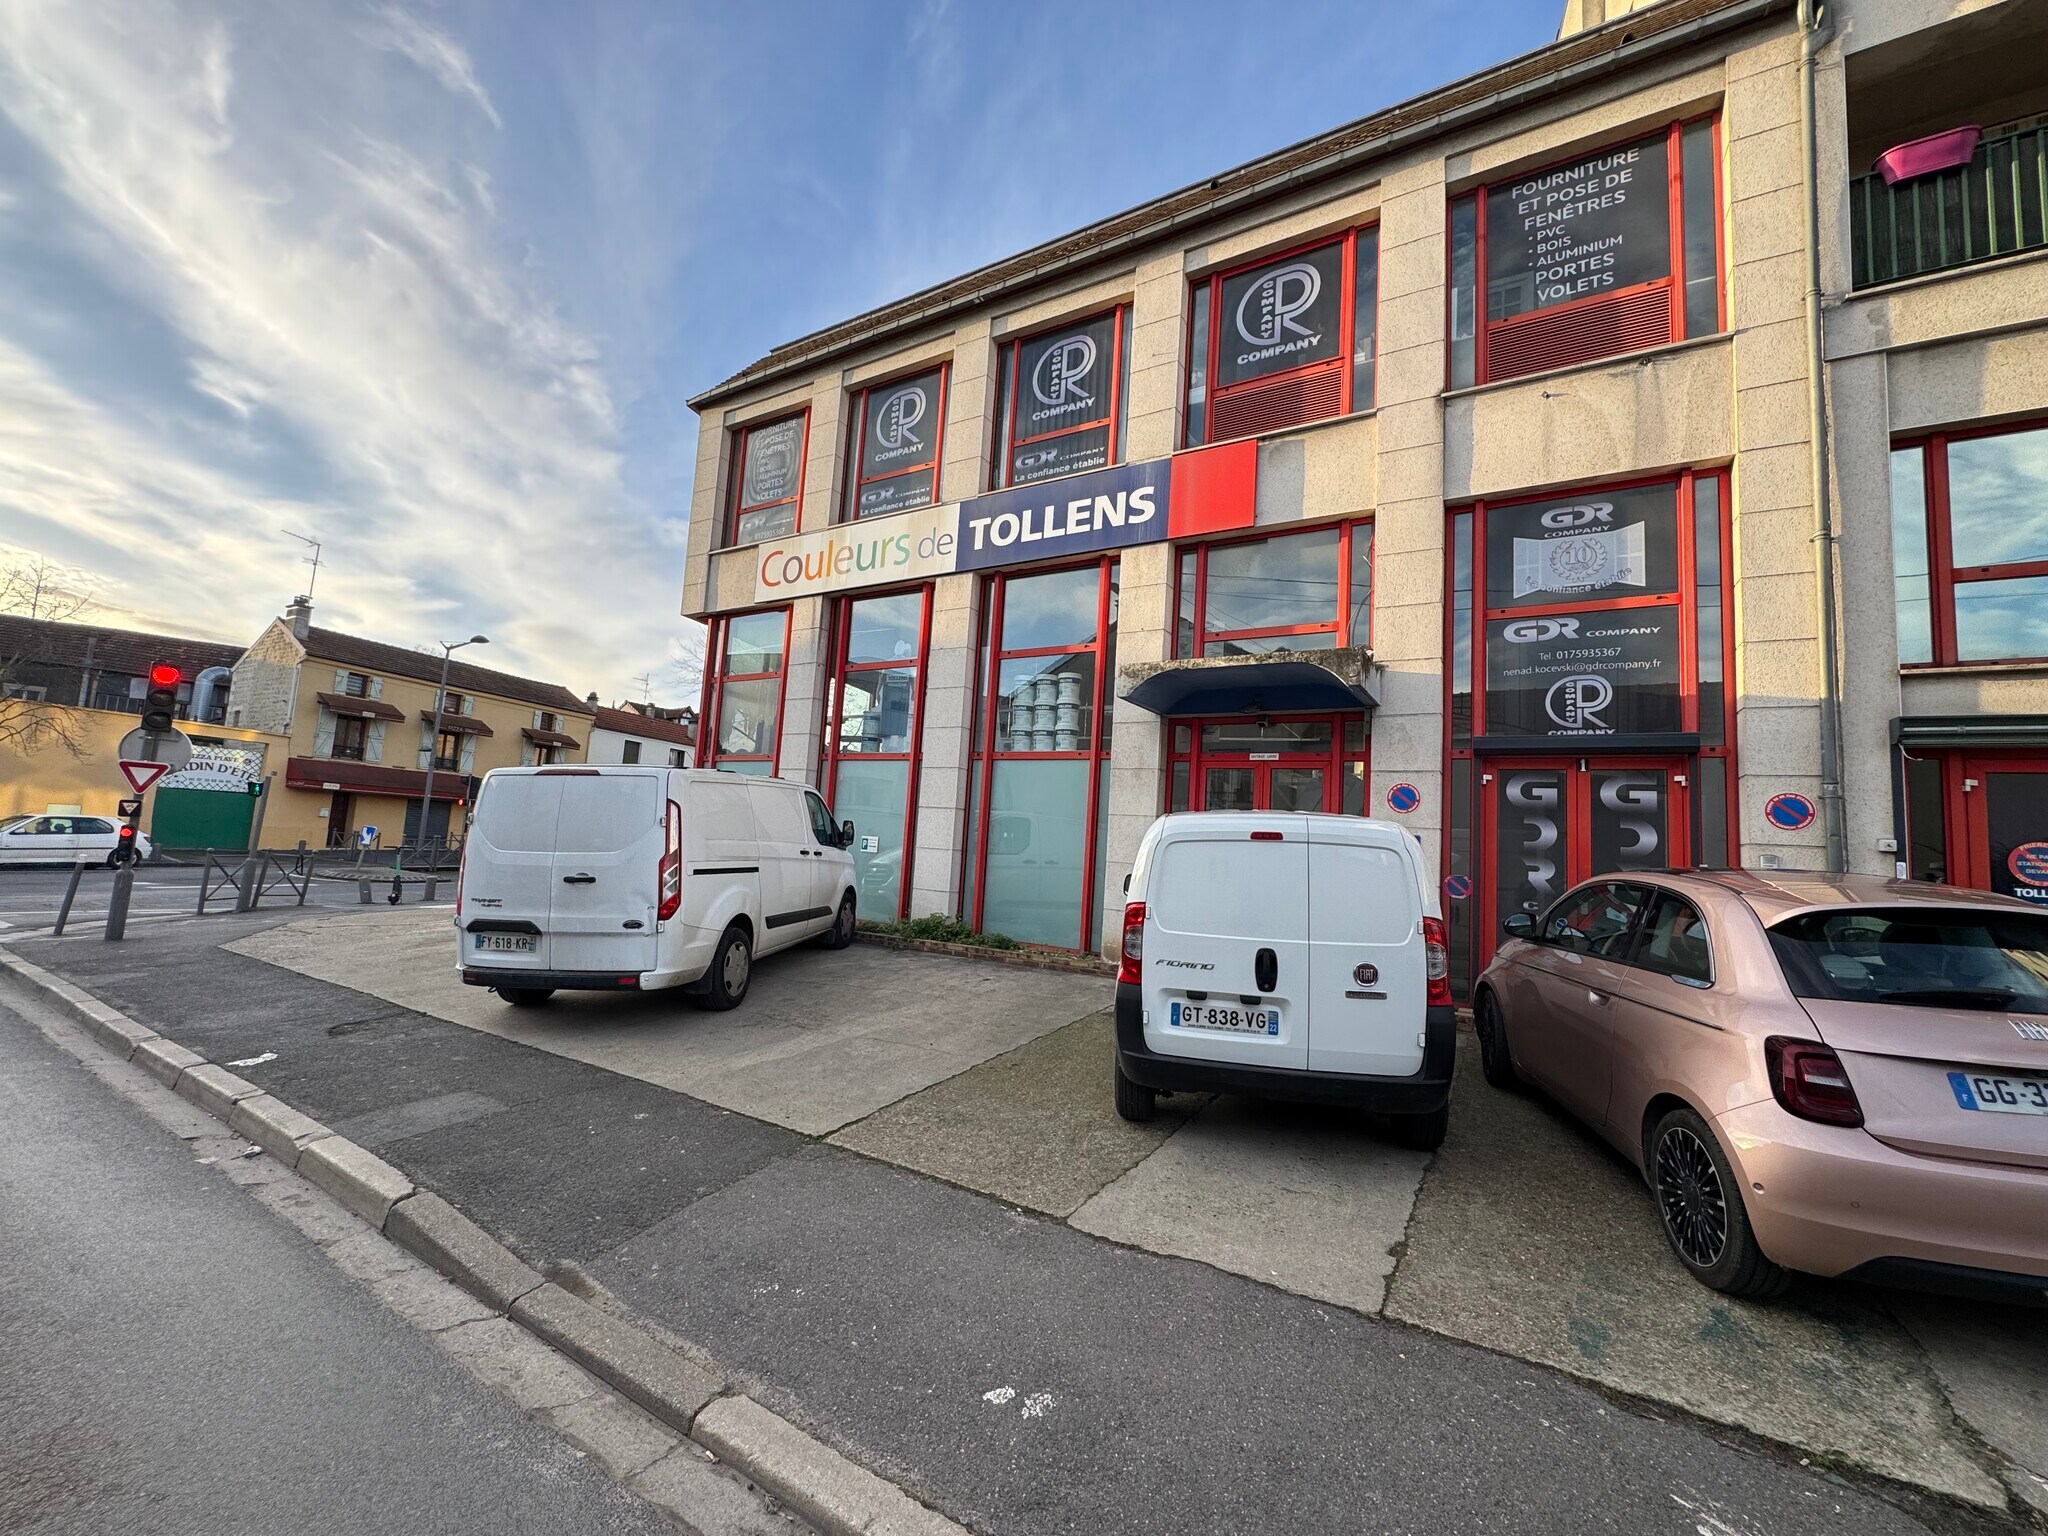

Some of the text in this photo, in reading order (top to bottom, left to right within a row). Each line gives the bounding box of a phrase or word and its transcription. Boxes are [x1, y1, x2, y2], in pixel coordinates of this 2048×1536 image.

[1512, 148, 1640, 199] FOURNITURE
[1518, 168, 1633, 215] ET POSE DE
[1524, 190, 1626, 230] FENÊTRES
[1537, 224, 1565, 240] PVC
[1537, 236, 1571, 253] BOIS
[1537, 234, 1622, 267] ALUMINIUM
[1536, 252, 1614, 284] PORTES
[1537, 272, 1614, 301] VOLETS
[1260, 280, 1274, 338] COMPANY
[1237, 334, 1322, 365] COMPANY
[1050, 349, 1062, 399] COMPANY
[1032, 396, 1096, 421] COMPANY
[754, 419, 798, 438] FOURNITURE
[765, 433, 784, 444] POSE
[784, 429, 795, 440] DE
[875, 442, 924, 462] COMPANY
[1015, 446, 1105, 470] GDR COMPANY
[1014, 456, 1106, 482] La confiance établie
[756, 488, 783, 501] VOLETS
[757, 477, 784, 490] PORTES
[860, 495, 931, 516] La confiance établie
[861, 486, 895, 505] GDR
[1540, 502, 1614, 529] GDR
[761, 486, 1156, 588] Couleurs de TOLLENS
[1544, 525, 1610, 539] COMPANY
[1565, 546, 1592, 564] 10
[1525, 567, 1632, 595] La confiance établie
[1503, 617, 1661, 644] GDR COMPANY
[1539, 647, 1622, 661] Tel. 0175935367
[1503, 658, 1662, 677] nenad.kocevski@gdrcompany.fr
[1565, 682, 1576, 723] COMPANY
[214, 755, 239, 763] PIAVE
[1579, 759, 1587, 771] 1
[2014, 888, 2048, 898] TOLL
[481, 936, 528, 950] FY-618-KR
[1155, 958, 1216, 971] FIORINO
[1360, 968, 1375, 981] FIAT
[1182, 1006, 1267, 1029] GT-838-VG
[1269, 1024, 1278, 1032] 22
[1973, 1078, 2048, 1108] GG-3
